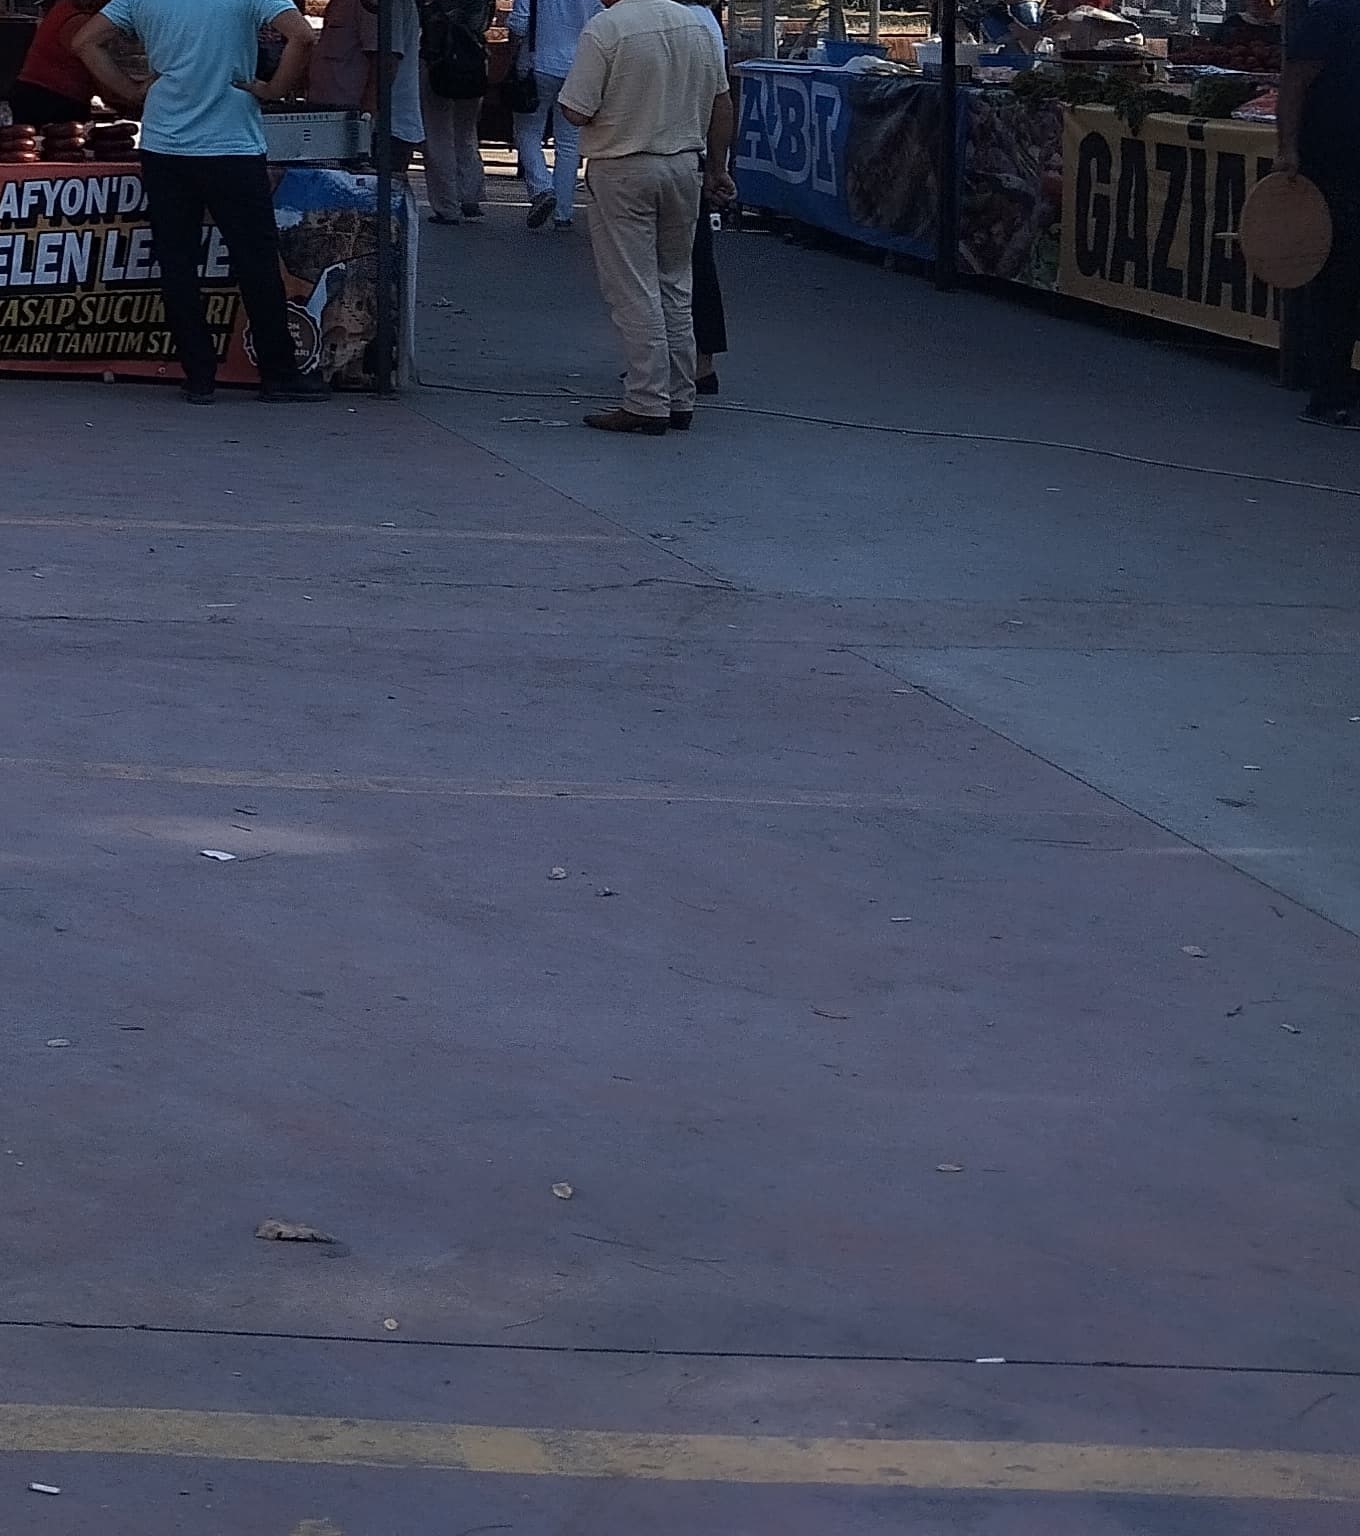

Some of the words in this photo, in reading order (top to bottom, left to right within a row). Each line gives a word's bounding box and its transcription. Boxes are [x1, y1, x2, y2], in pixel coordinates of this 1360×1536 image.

[1075, 119, 1279, 321] GAZİA
[79, 292, 236, 326] SUCUKRI
[48, 331, 146, 355] TANITIM
